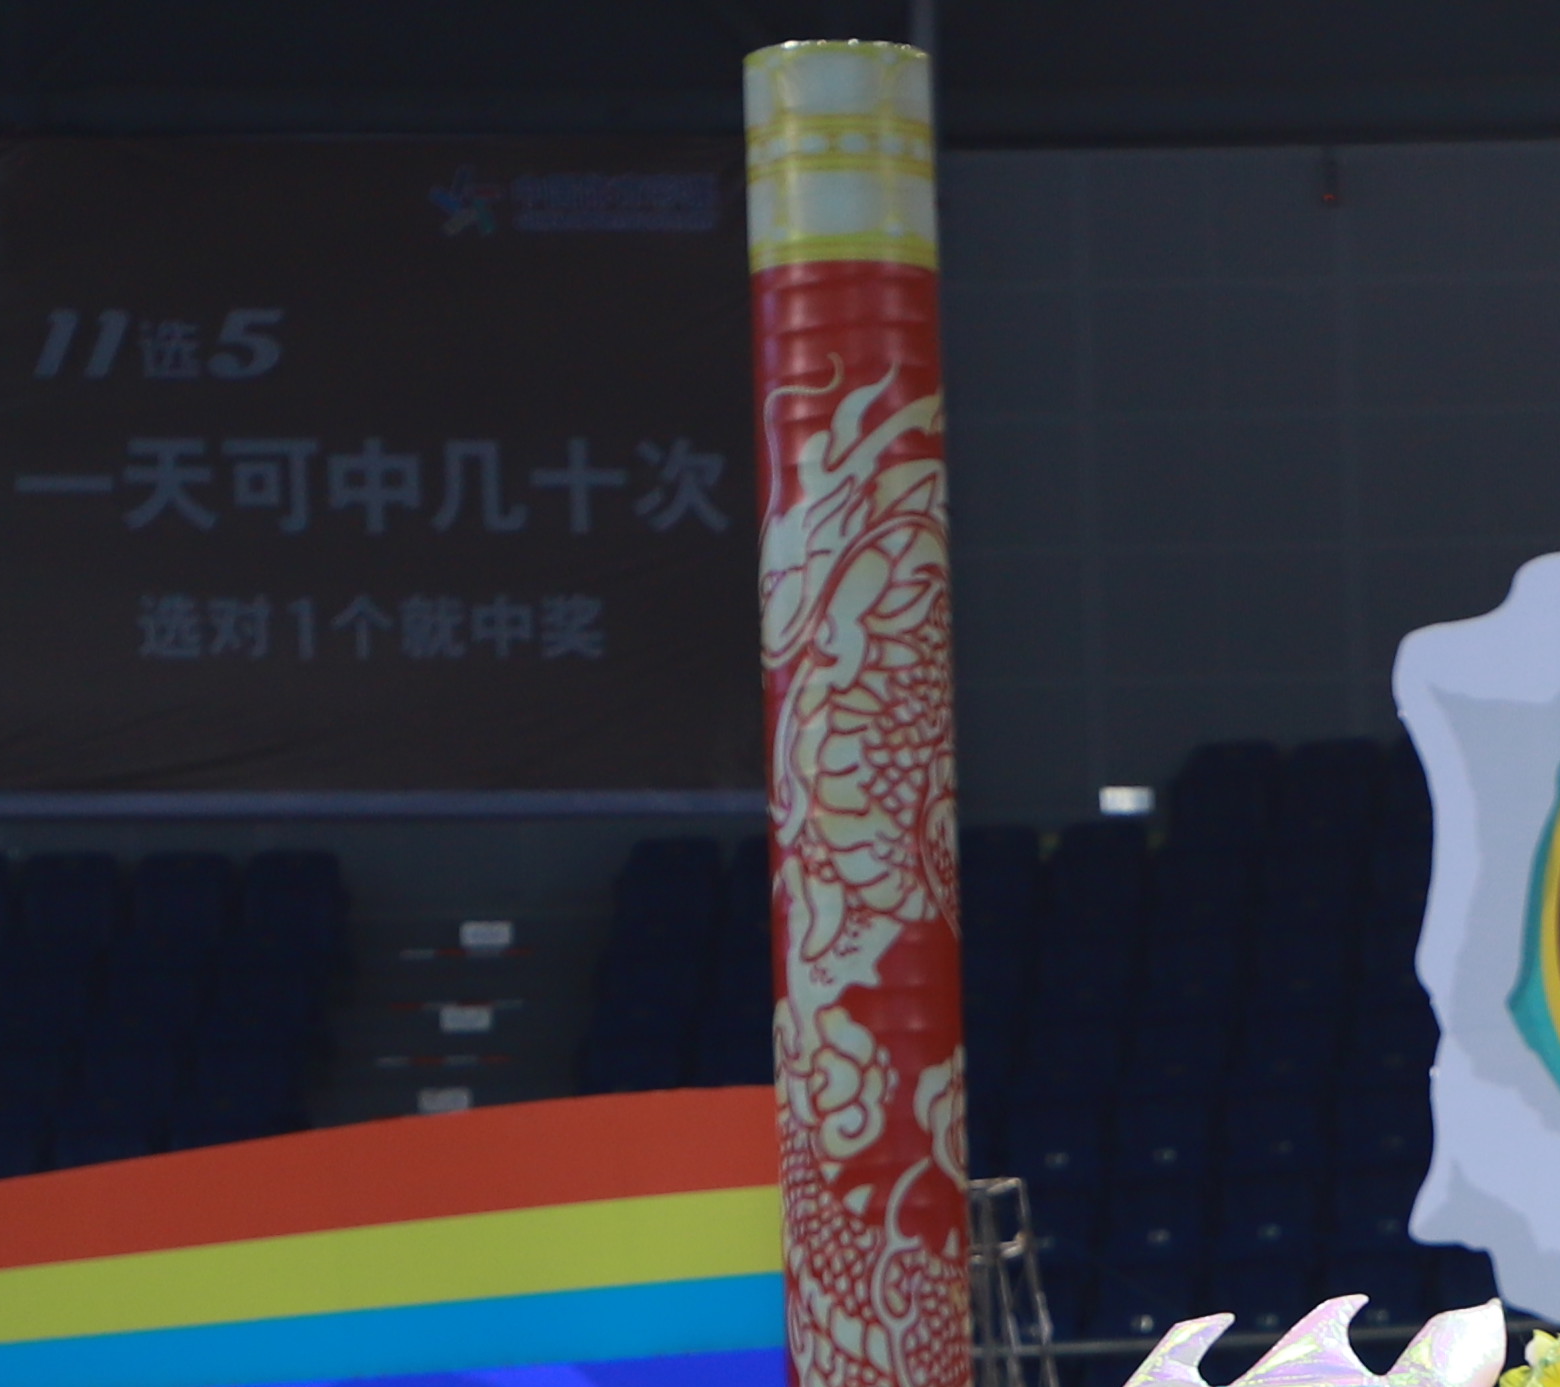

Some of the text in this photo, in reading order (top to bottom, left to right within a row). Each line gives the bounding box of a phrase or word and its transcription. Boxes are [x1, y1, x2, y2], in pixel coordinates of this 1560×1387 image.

[34, 308, 286, 380] 11选5
[13, 435, 731, 534] 一天可中几十次
[138, 593, 606, 661] 选对1个就中奖
